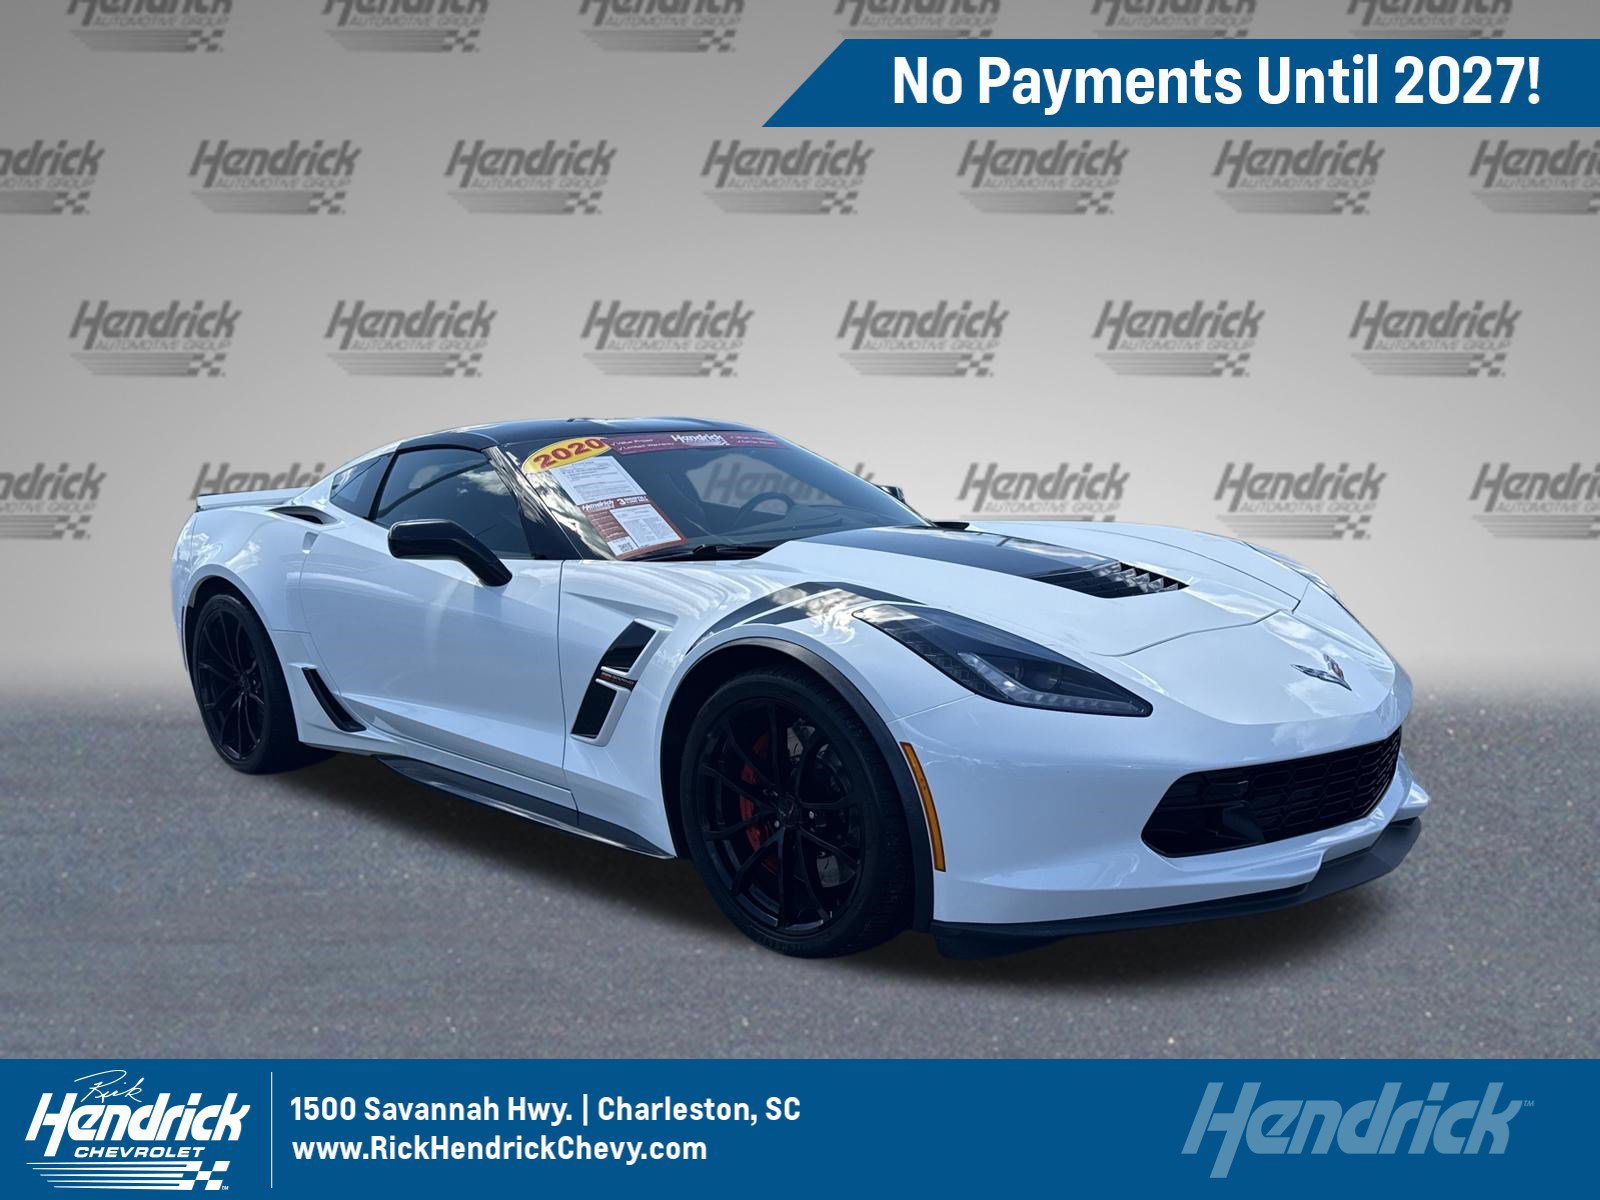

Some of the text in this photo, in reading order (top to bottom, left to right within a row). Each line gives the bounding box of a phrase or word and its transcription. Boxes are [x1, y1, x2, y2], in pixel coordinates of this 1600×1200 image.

[0, 138, 106, 176] ndrick
[188, 138, 362, 188] Hendrick
[444, 138, 618, 188] Hendrick
[700, 138, 874, 188] Hendrick
[956, 138, 1130, 188] Hendrick
[1212, 138, 1386, 188] Hendrick
[1468, 138, 1600, 188] Hendri
[68, 300, 242, 350] Hendrick
[324, 300, 498, 350] Hendrick
[580, 300, 754, 350] Hendrick
[836, 300, 1010, 350] Hendrick
[1092, 300, 1266, 350] Hendrick
[1348, 300, 1522, 350] Hendrick
[533, 438, 606, 469] 2020
[0, 462, 107, 500] ndrick
[190, 462, 326, 500] Hendri
[957, 462, 1131, 512] Hendrick
[1213, 462, 1387, 512] Hendrick
[1469, 462, 1600, 512] Hendri
